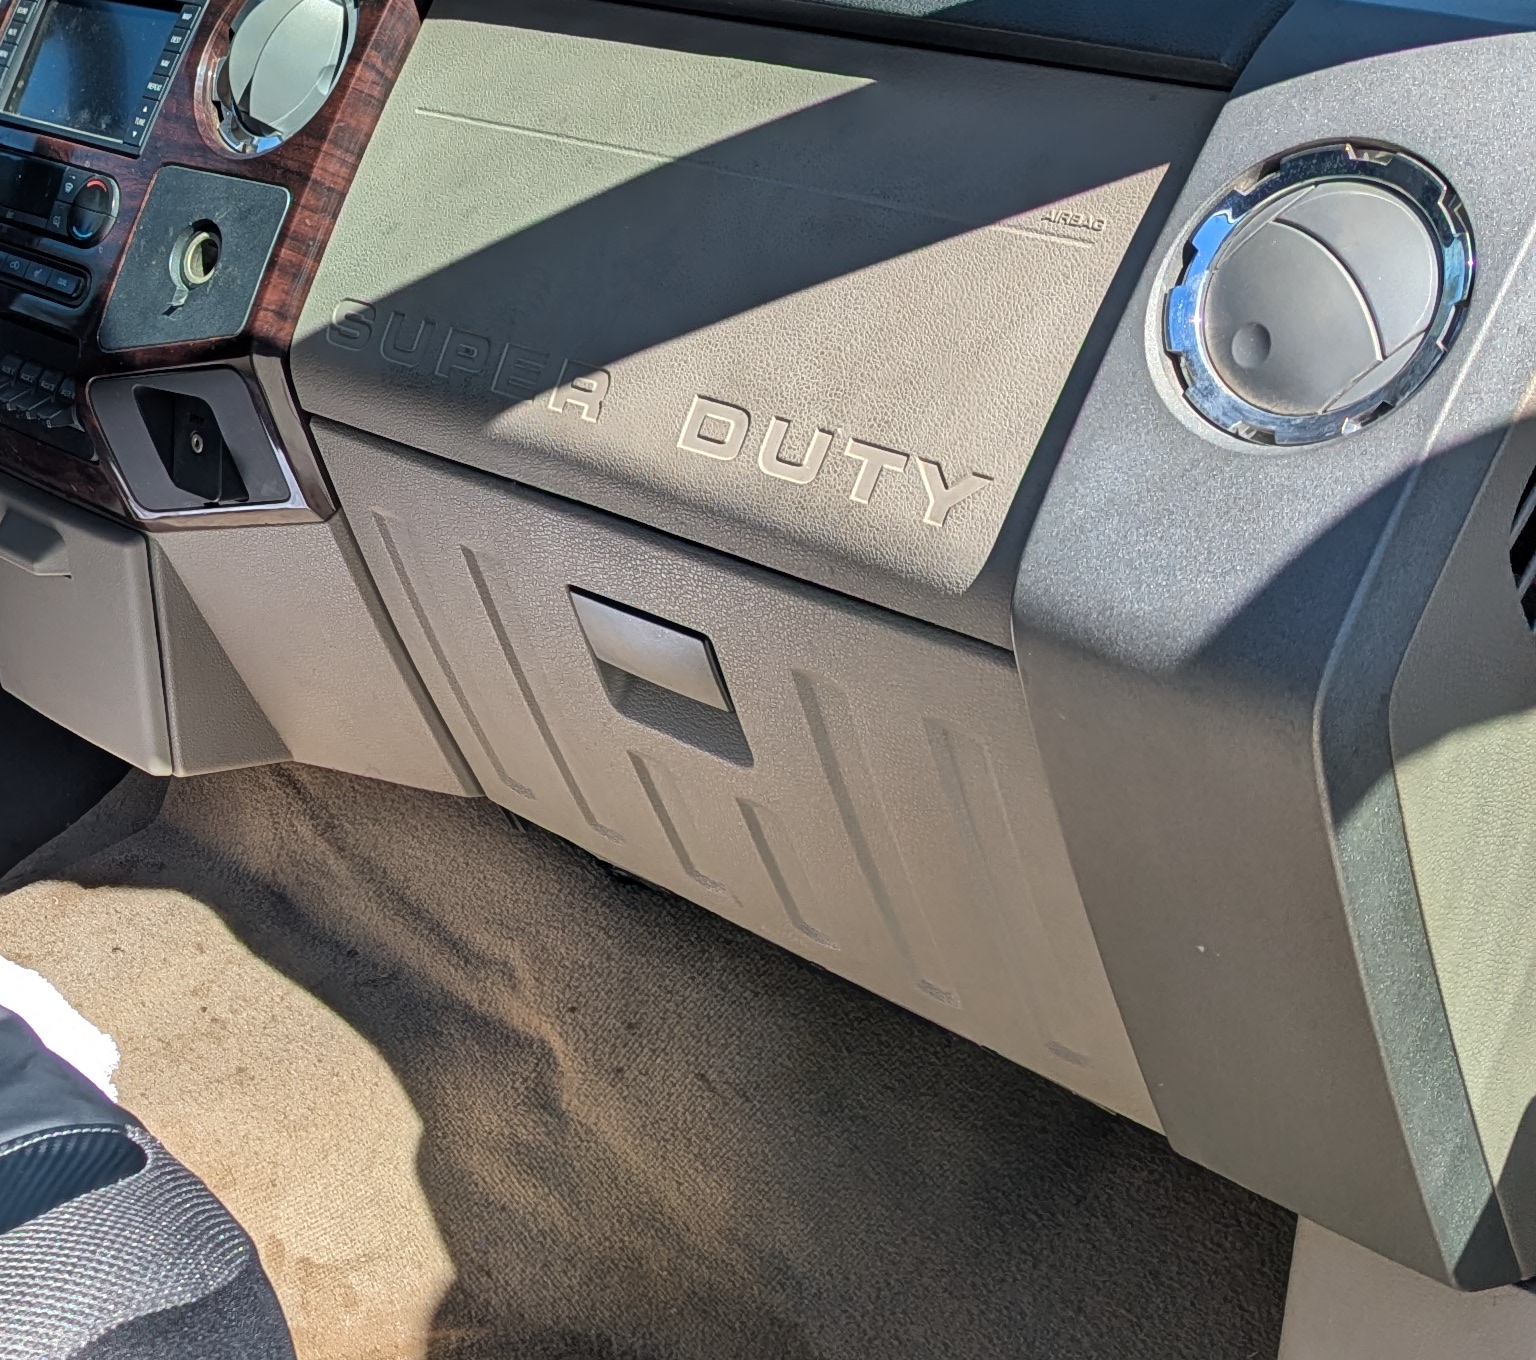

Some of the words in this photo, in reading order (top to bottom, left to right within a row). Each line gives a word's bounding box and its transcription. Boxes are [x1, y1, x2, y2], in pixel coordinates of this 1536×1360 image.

[1040, 207, 1106, 232] AIRBAG
[325, 297, 611, 423] SUPER
[676, 393, 995, 528] DUTY
